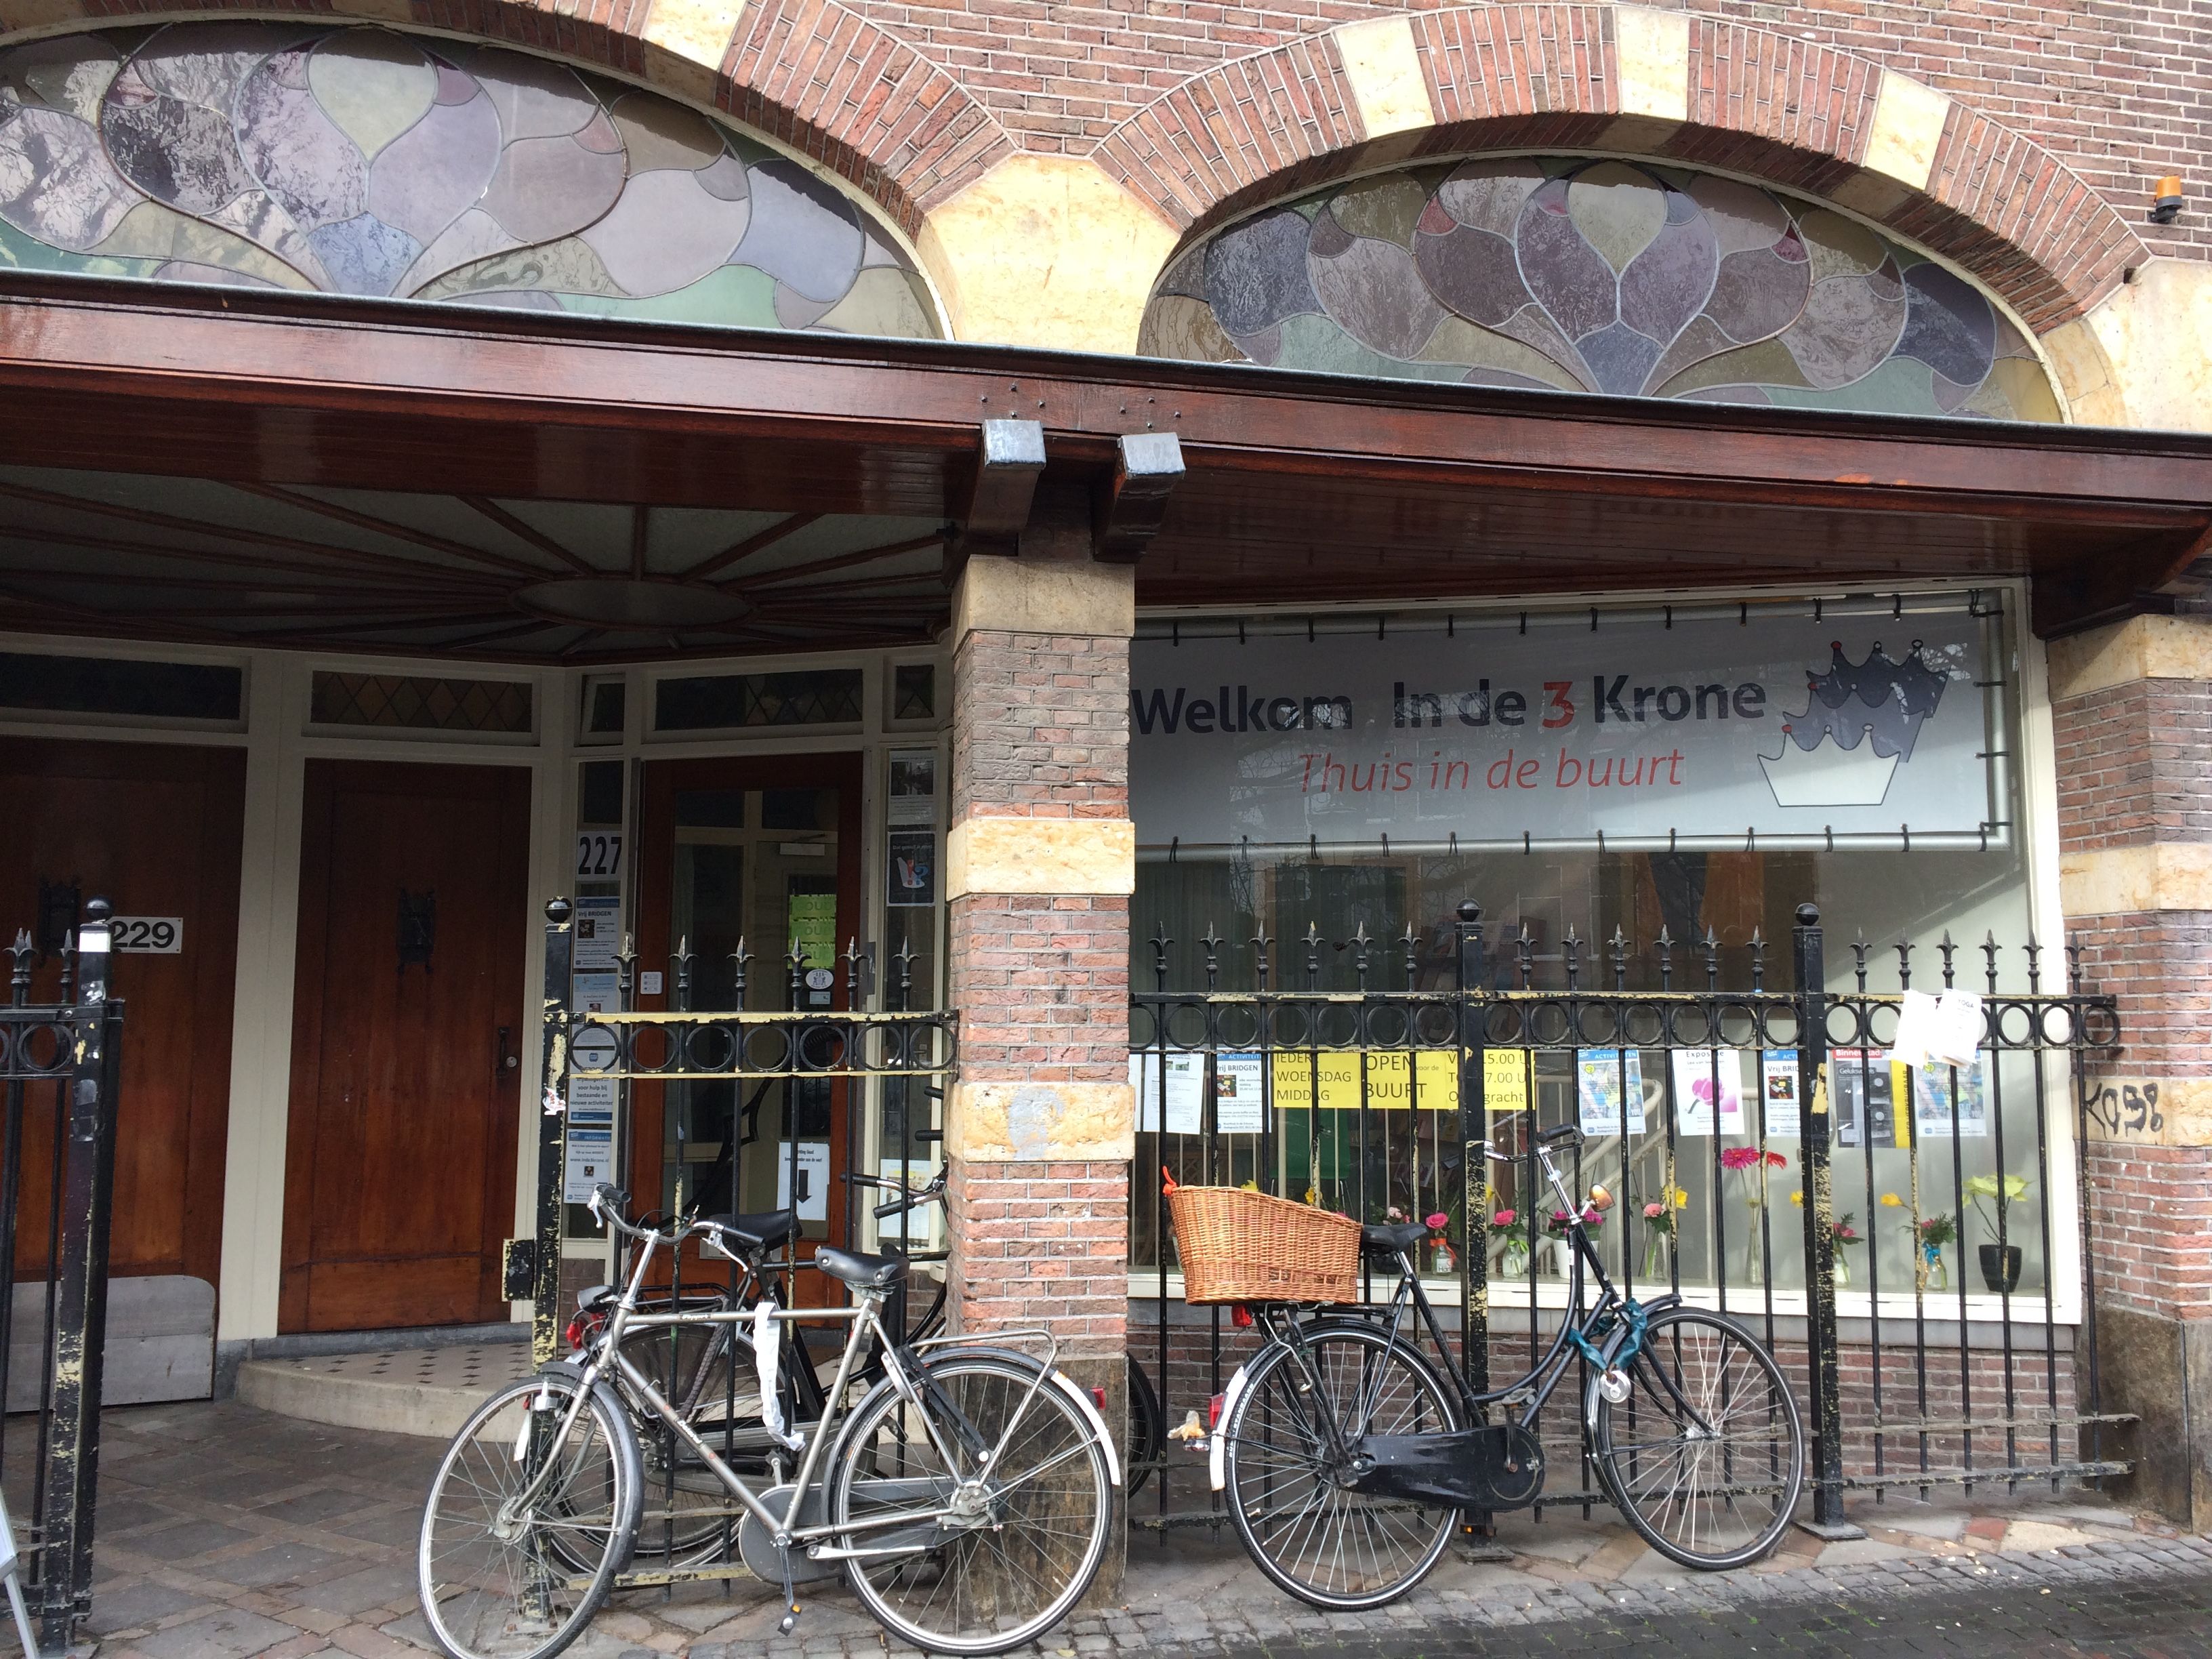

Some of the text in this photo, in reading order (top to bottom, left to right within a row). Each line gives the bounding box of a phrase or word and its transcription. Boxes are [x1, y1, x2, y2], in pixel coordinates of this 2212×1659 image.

[1130, 674, 1767, 735] Welkom In de 3 Krone
[1297, 747, 1685, 793] Thuis in de buurt
[578, 836, 622, 875] 227
[112, 920, 175, 949] 229
[1957, 998, 1974, 1008] YOGA
[1277, 1052, 1313, 1063] IEDER
[1595, 1051, 1637, 1059] ACTIVITTEN
[1767, 1065, 1780, 1073] Vrij
[1485, 1072, 1513, 1084] 7.00
